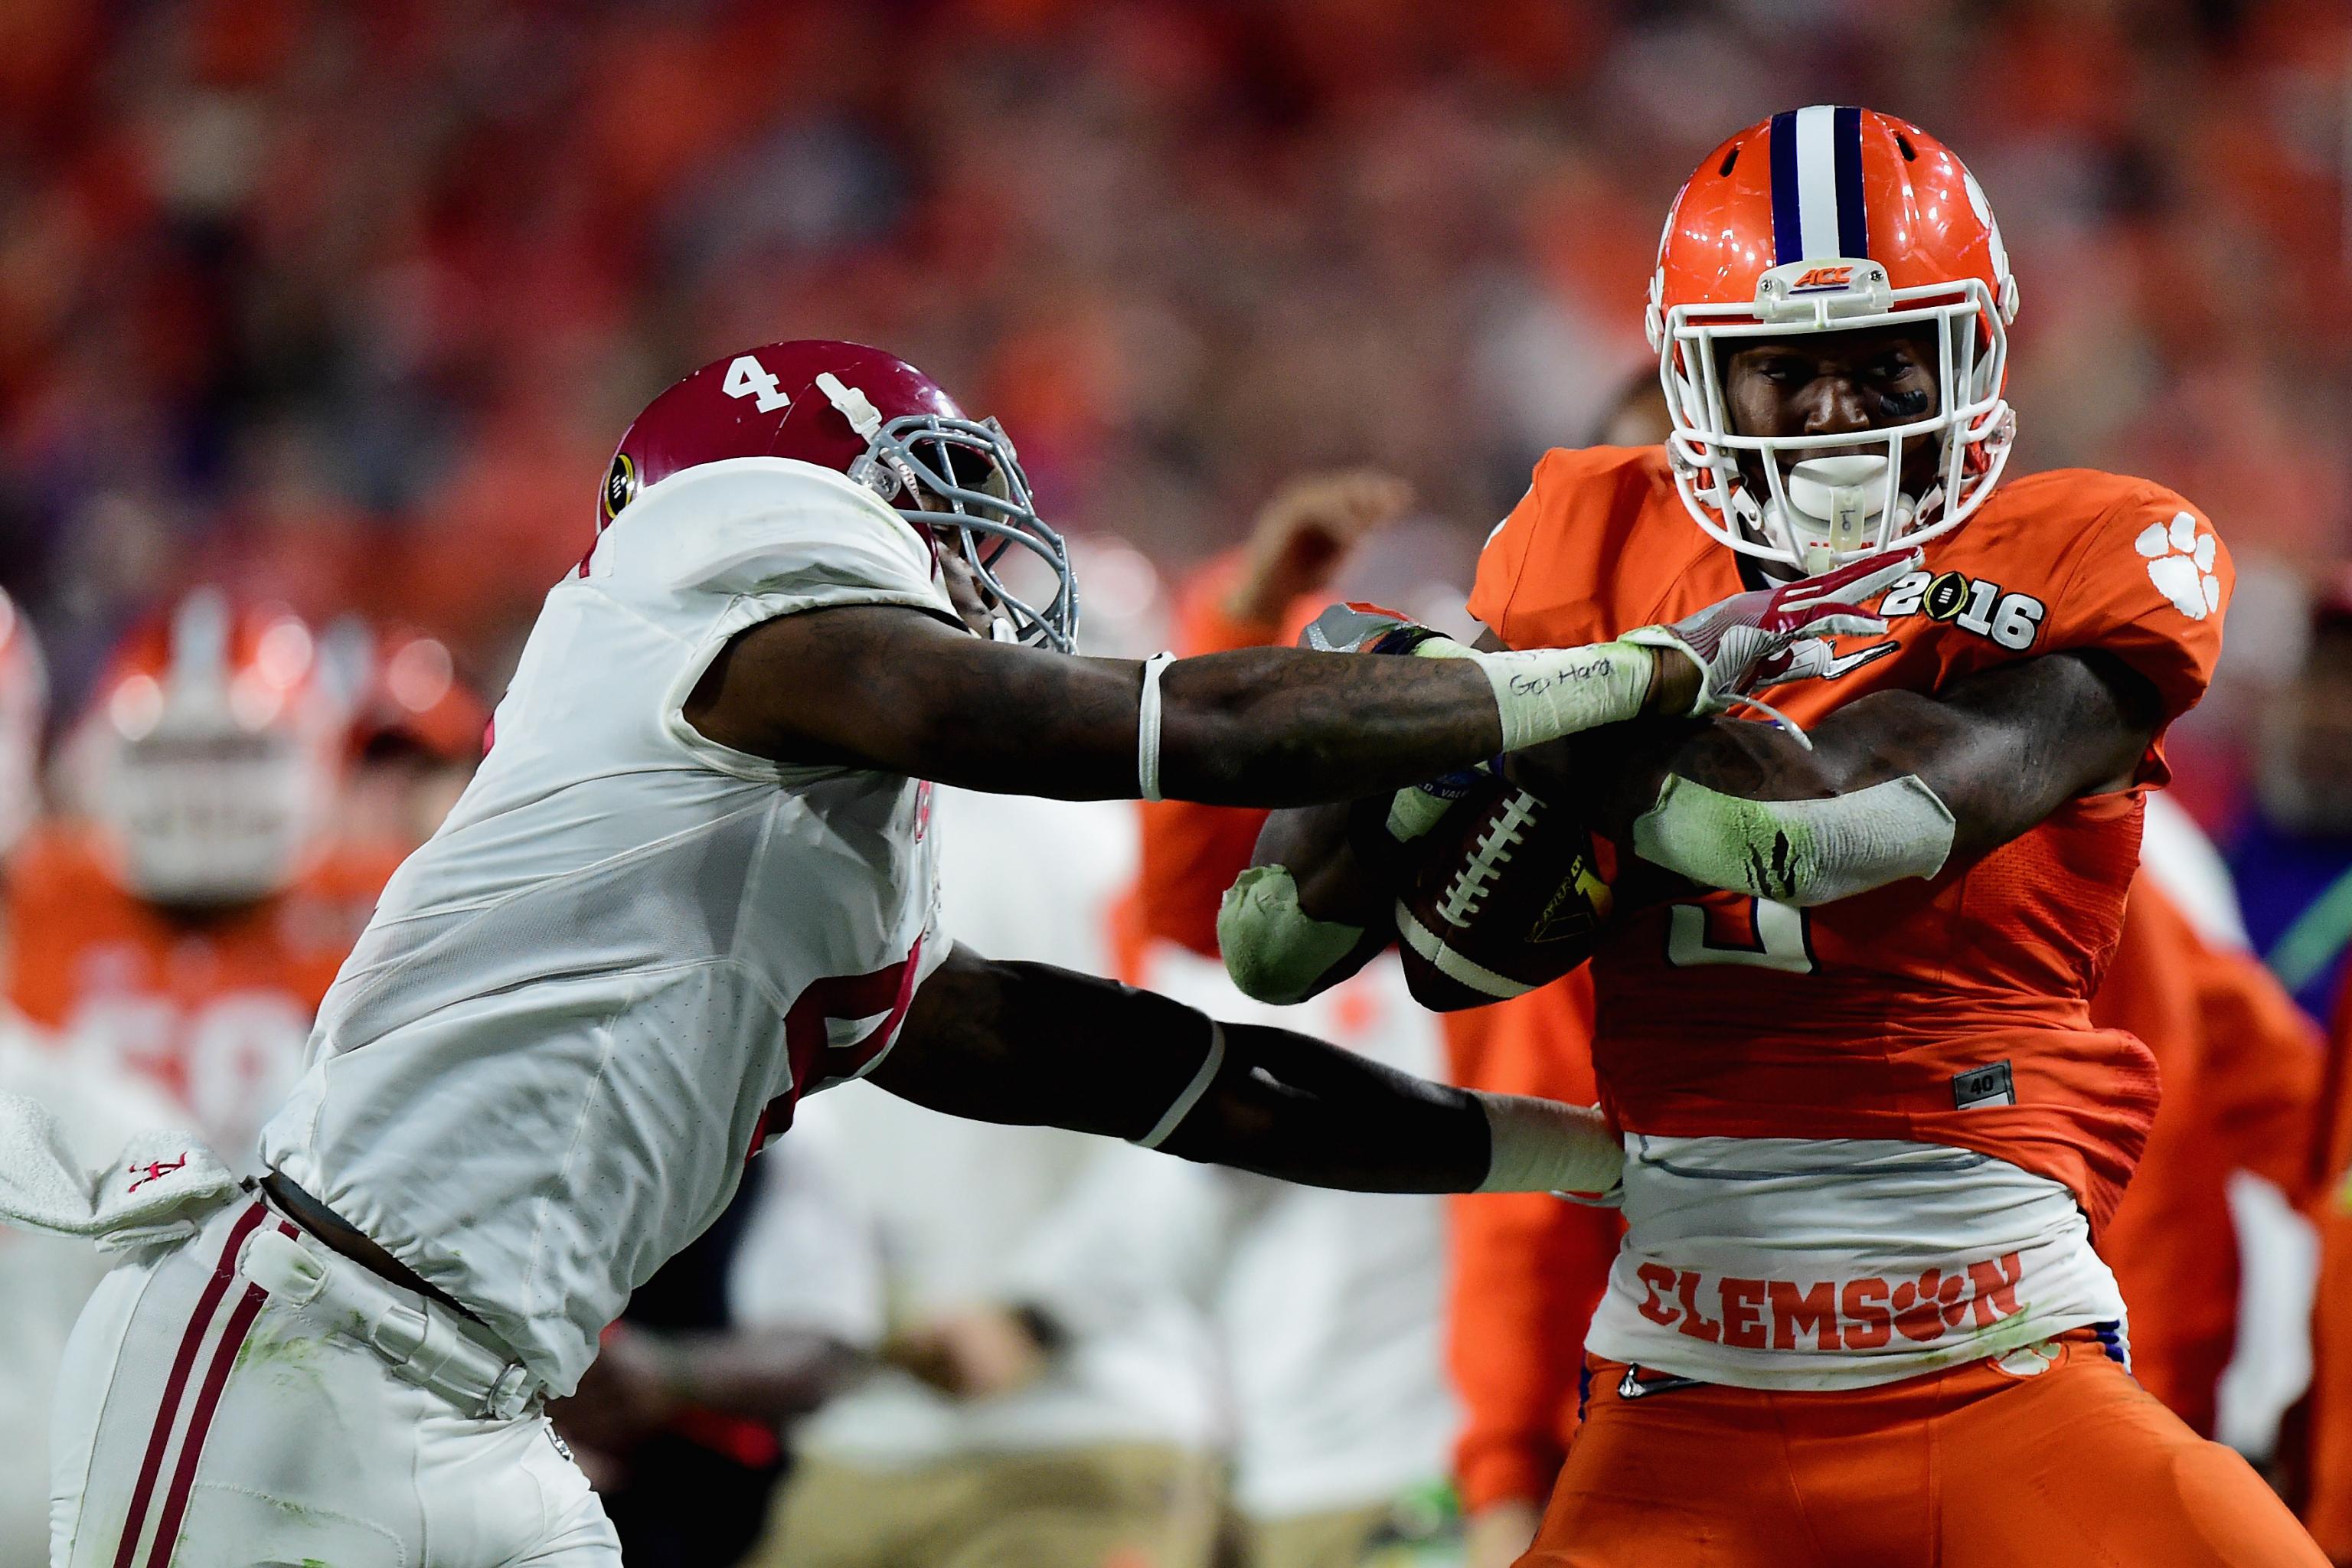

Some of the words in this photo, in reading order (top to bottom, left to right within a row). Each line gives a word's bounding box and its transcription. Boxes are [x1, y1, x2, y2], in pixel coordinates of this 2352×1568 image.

[1793, 266, 1854, 287] ACC
[722, 355, 791, 413] 4
[1509, 674, 1550, 696] Go
[1971, 1074, 1994, 1095] 40
[1637, 1250, 2025, 1351] CLEMSON
